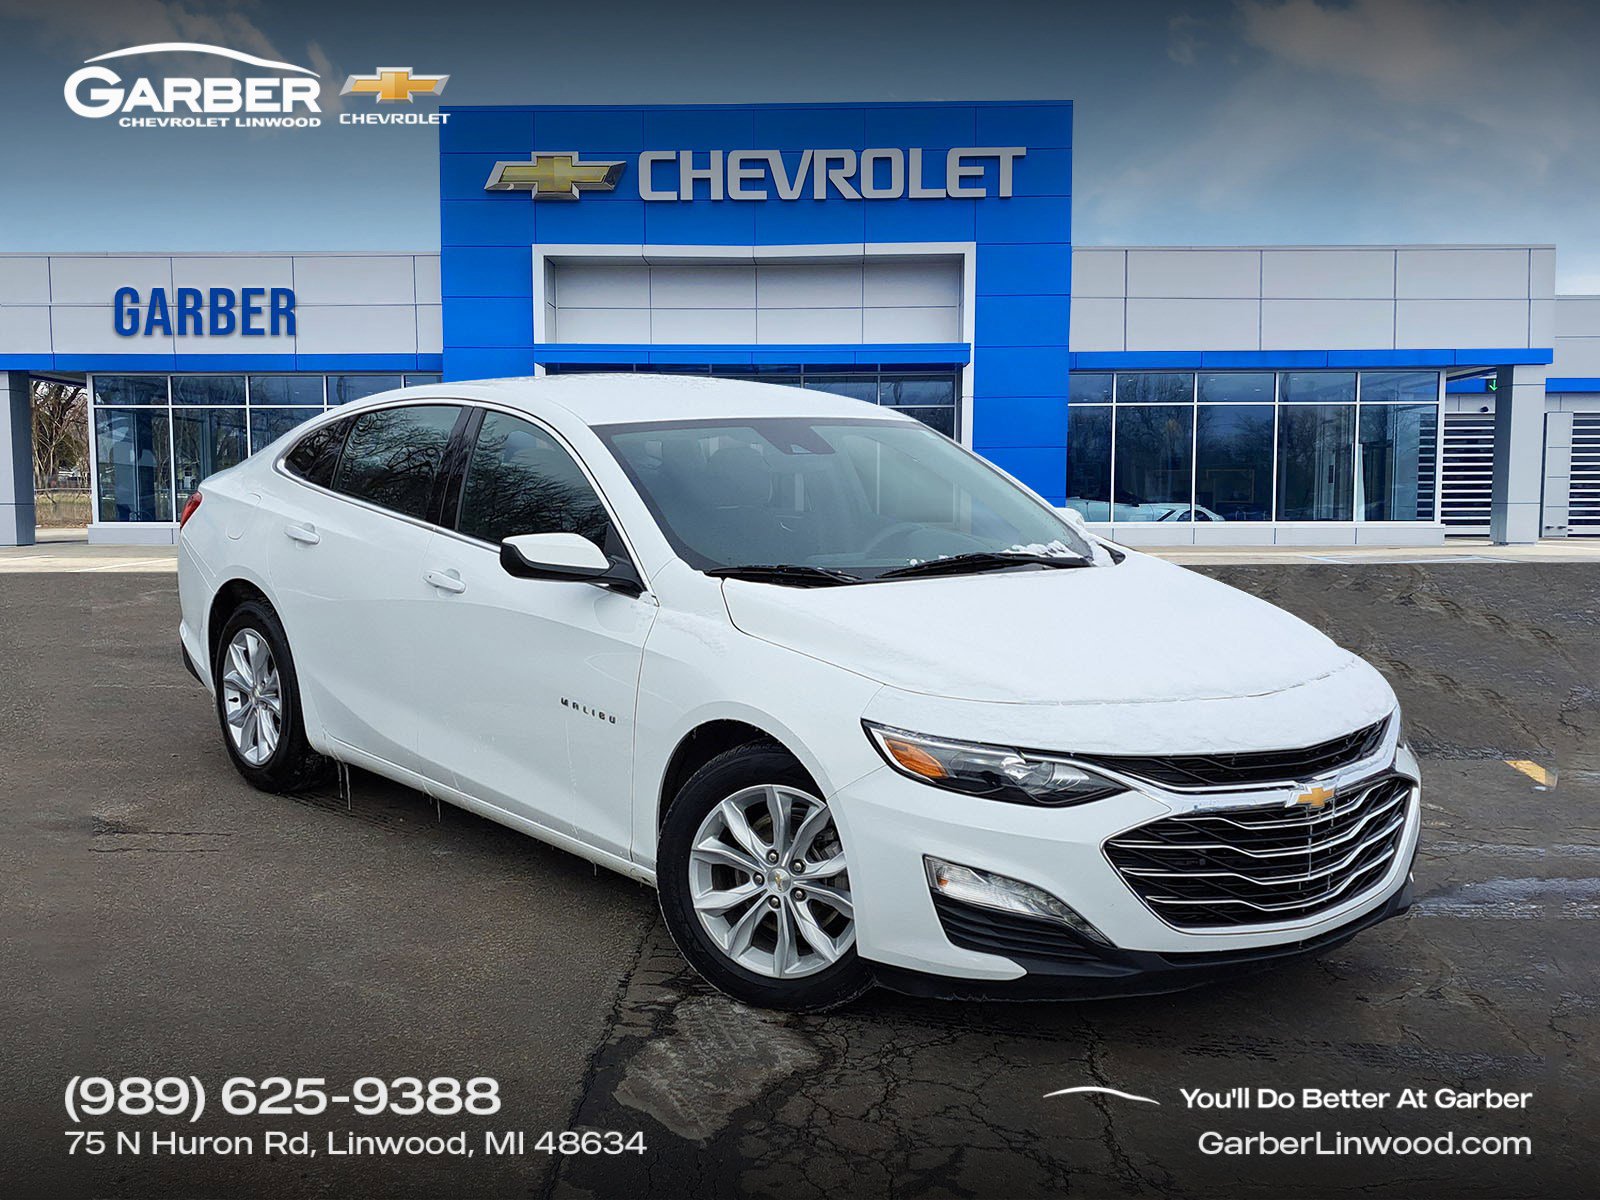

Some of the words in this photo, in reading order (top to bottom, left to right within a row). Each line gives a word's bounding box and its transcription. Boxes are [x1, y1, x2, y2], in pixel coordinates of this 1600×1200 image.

[638, 146, 1027, 201] CHEVROLET
[113, 286, 297, 336] GARBER
[560, 697, 617, 725] MALIBU
